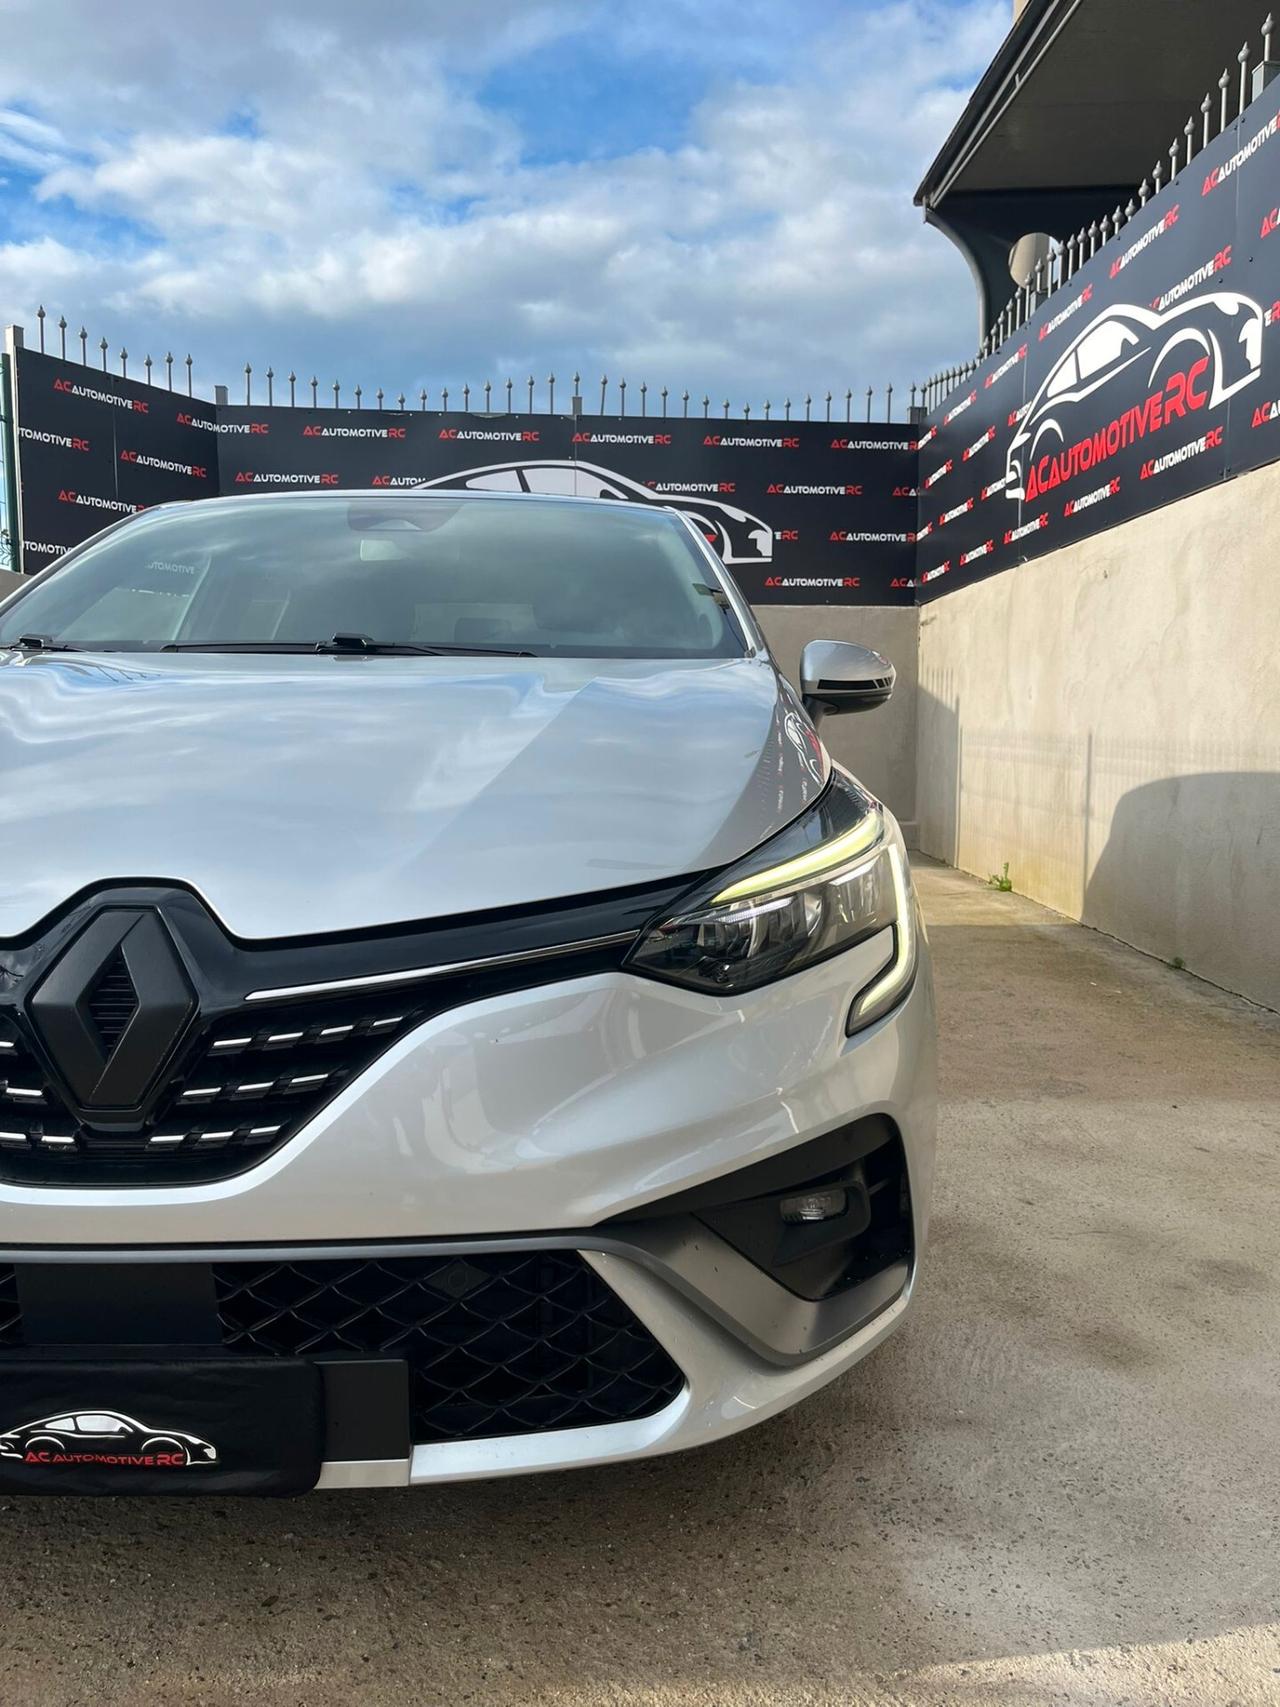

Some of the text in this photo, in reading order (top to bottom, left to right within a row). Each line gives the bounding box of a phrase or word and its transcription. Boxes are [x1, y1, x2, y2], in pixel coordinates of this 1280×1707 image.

[1201, 109, 1280, 197] ACAUTOMOTIVE
[54, 378, 149, 413] ACAUTOMOTIVERC
[176, 412, 269, 434] ACAUTOMOTIVERC
[1026, 355, 1210, 502] ACAUTOMOTIVERC
[303, 425, 405, 438] ACAUTOMOTIVERC
[439, 429, 540, 442] ACAUTOMOTIVERC
[572, 432, 671, 445] ACAUTOMOTIVERC
[703, 435, 800, 448] ACAUTOMOTIVERC
[1140, 426, 1223, 480] ACAUTOMOTIVERC
[120, 449, 207, 478] ACAUTOMOTIVERC
[235, 472, 339, 485] ACAUTOMOTIVERC
[766, 483, 862, 495] ACAUTOMOTIVERC
[830, 531, 917, 543] ACAUTOMOTIVER
[765, 576, 860, 588] ACAUTOMOTIVERC
